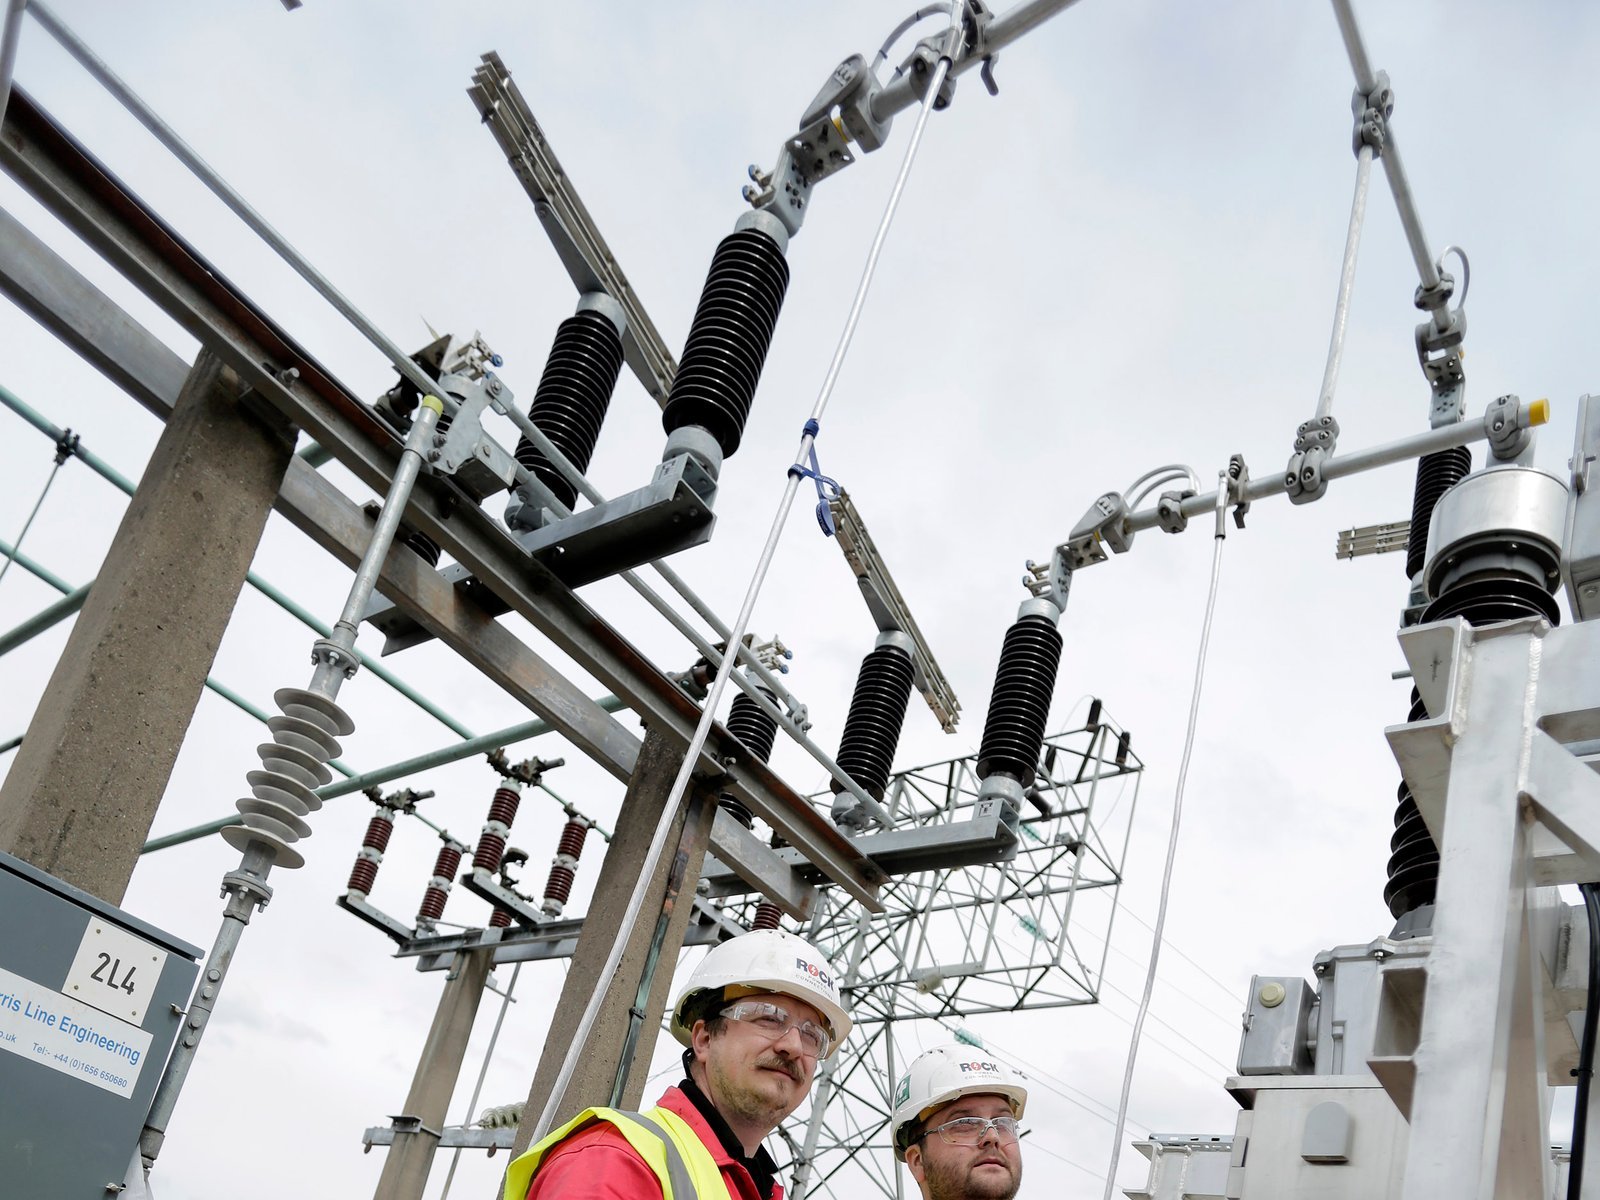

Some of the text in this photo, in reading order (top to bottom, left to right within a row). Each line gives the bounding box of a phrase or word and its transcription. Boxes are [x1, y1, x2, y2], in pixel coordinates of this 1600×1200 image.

[90, 952, 137, 995] 2L4
[796, 957, 834, 992] ROCK
[24, 1001, 56, 1026] Line
[59, 1016, 141, 1066] Engineering
[54, 1053, 69, 1064] +44
[100, 1071, 128, 1087] 650680
[959, 1061, 1000, 1073] ROCK
